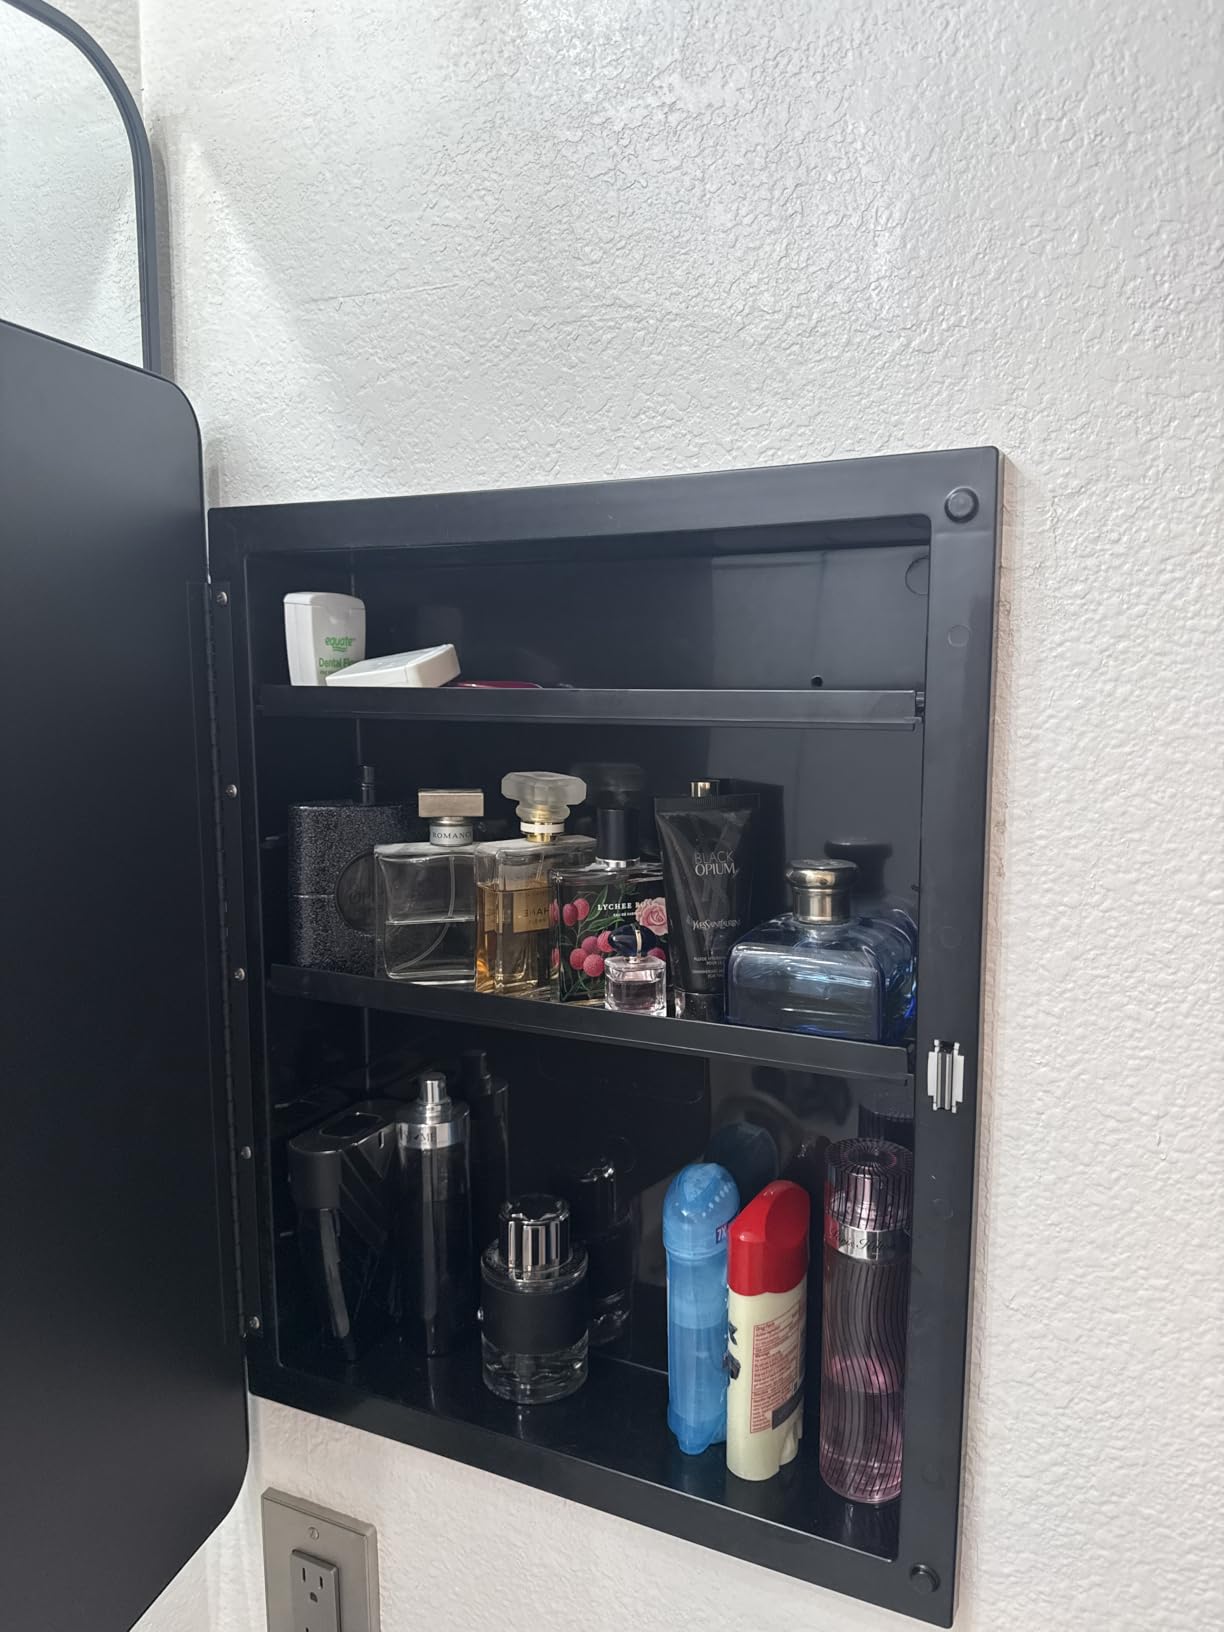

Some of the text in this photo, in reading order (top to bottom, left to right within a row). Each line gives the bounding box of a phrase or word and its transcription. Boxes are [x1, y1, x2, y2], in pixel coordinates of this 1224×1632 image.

[325, 636, 353, 648] equate
[319, 657, 342, 668] Dental
[694, 851, 735, 865] BLACK
[695, 863, 736, 877] OPIUM
[597, 902, 632, 911] LYCHEE
